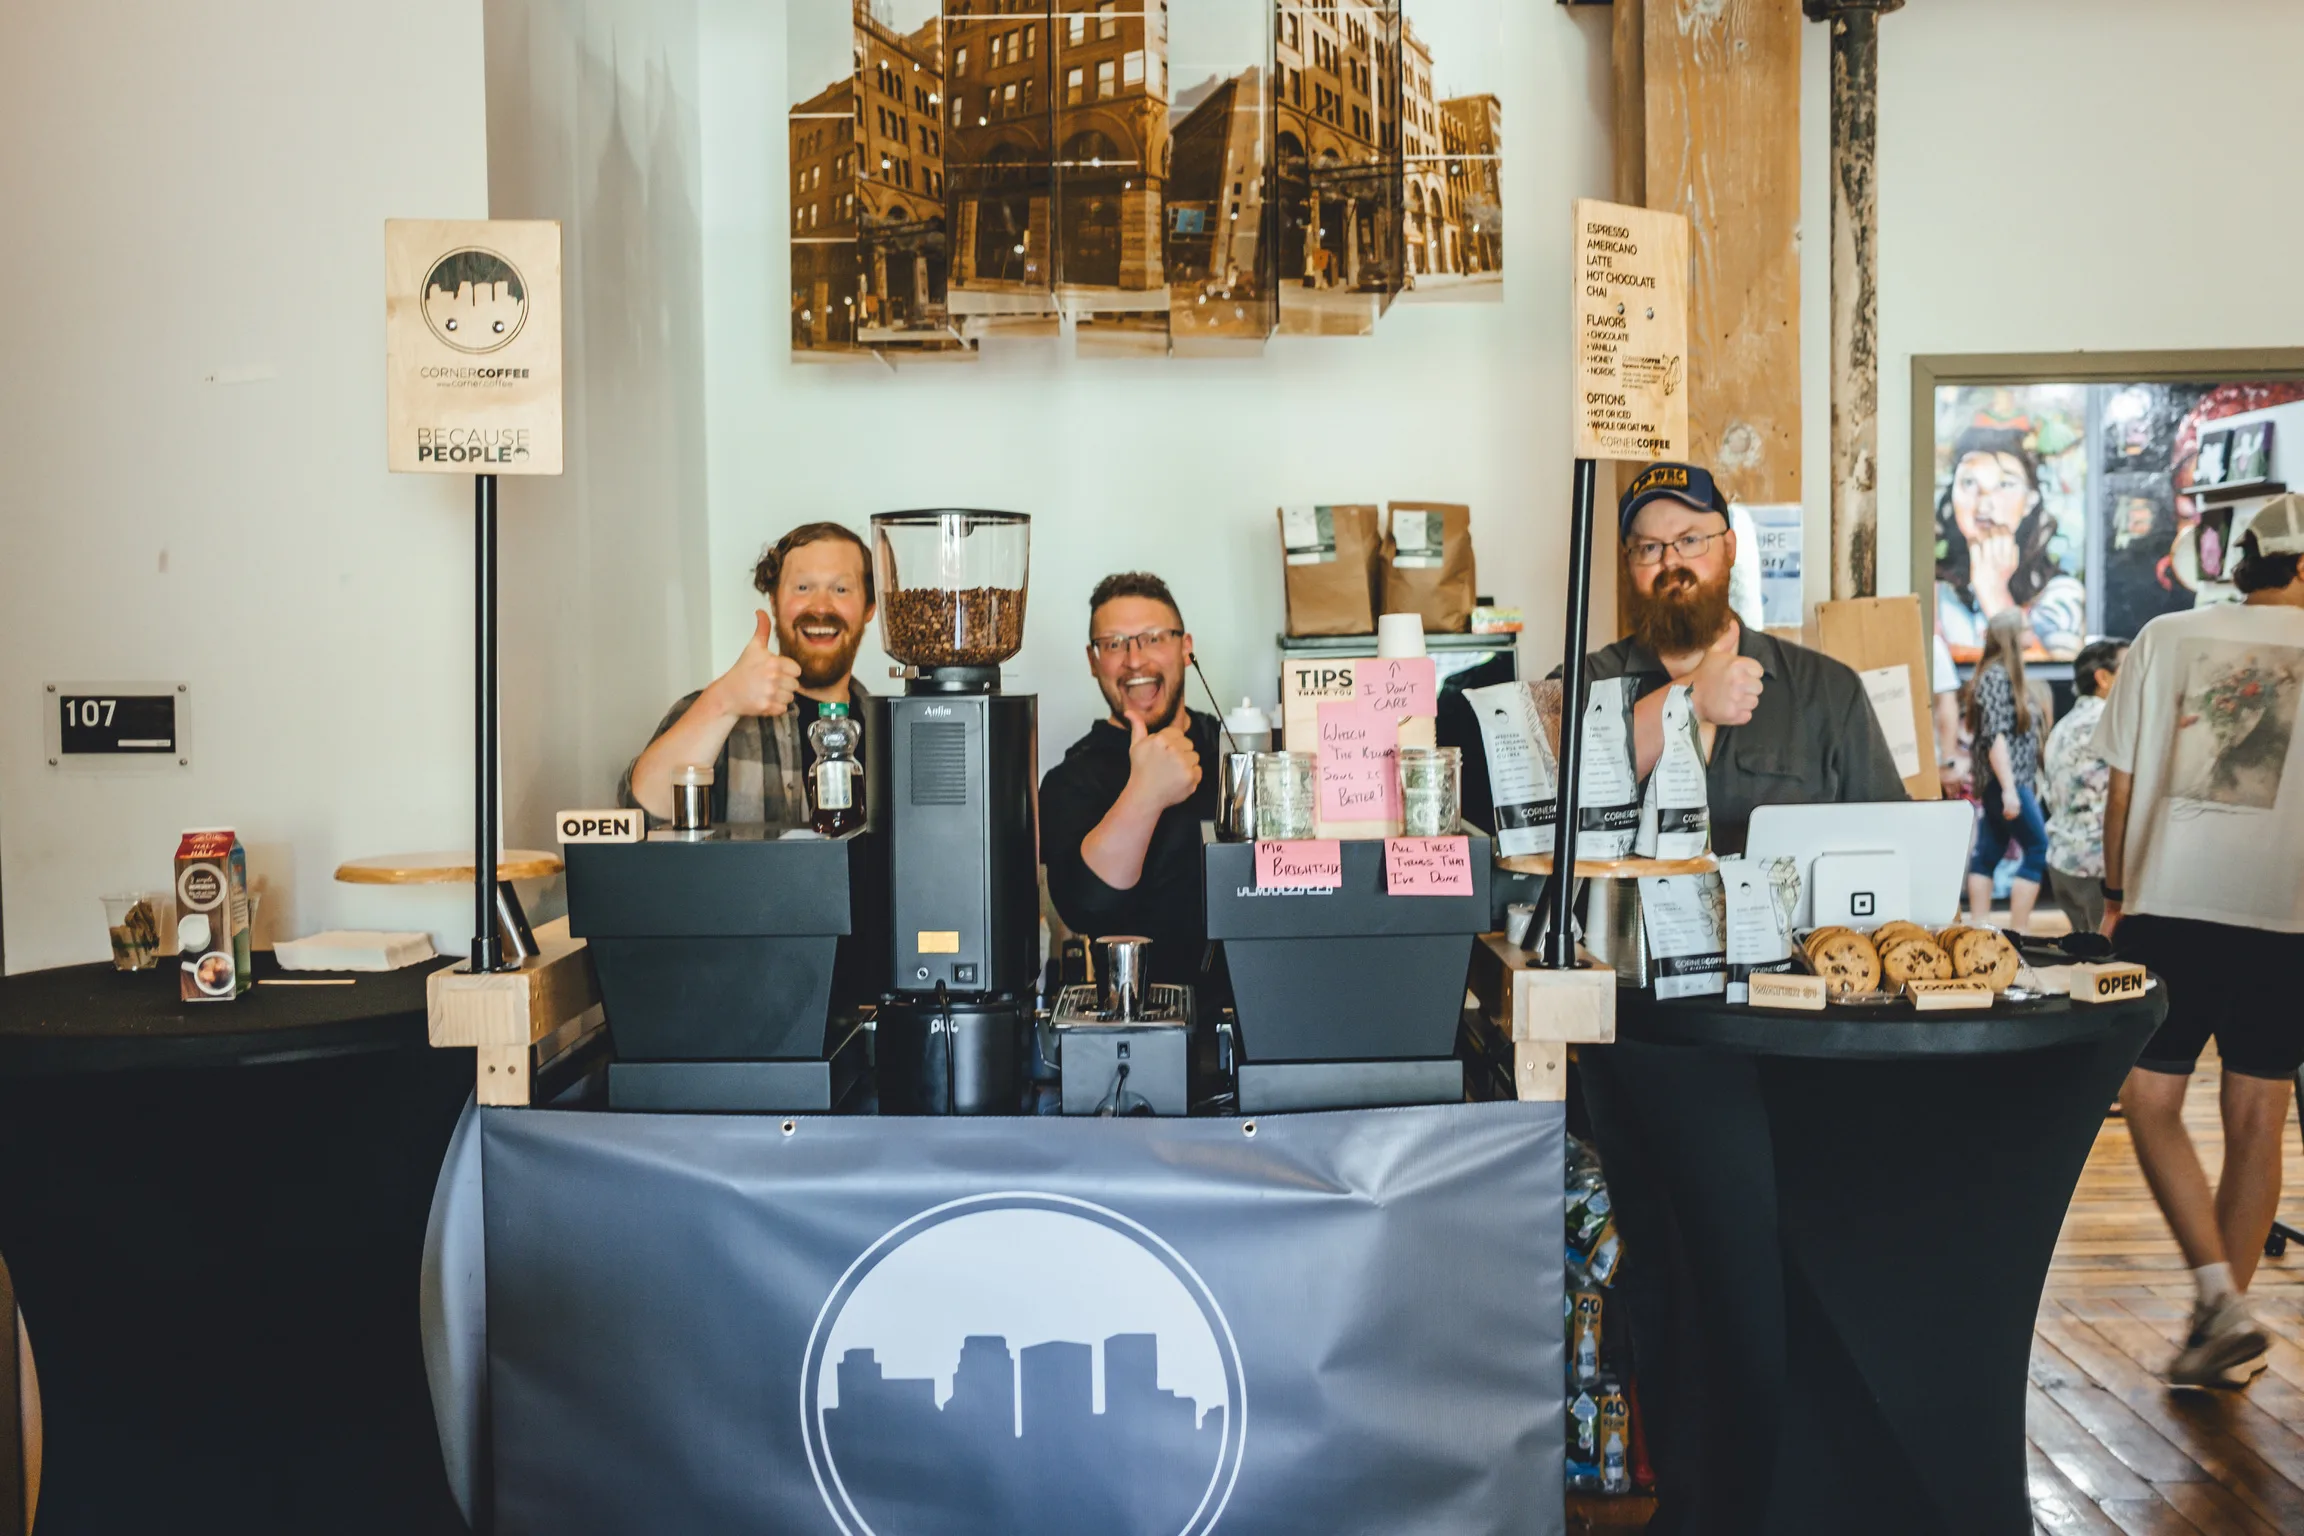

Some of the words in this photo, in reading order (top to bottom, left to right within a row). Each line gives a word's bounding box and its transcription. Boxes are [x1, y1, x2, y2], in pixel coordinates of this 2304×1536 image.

[1586, 222, 1630, 239] ESPRESSO
[1586, 238, 1638, 256] AMERICANO
[1586, 253, 1613, 268] LATTE
[1586, 270, 1604, 282] HOT
[1605, 272, 1656, 289] CHOCOLATE
[1586, 285, 1607, 298] CHAI
[1586, 313, 1627, 329] FLAVORS
[1590, 330, 1629, 342] CHOCOLATE
[1590, 342, 1618, 353] VANILLA
[1590, 354, 1614, 364] HONEY
[420, 367, 529, 379] CORNERCOFFEE
[1590, 366, 1616, 377] NORDIC
[1586, 391, 1626, 407] OPTIONS
[1590, 408, 1604, 418] HOT
[1605, 409, 1616, 419] OR
[1616, 410, 1632, 420] ICED
[1590, 420, 1616, 431] WHOLE
[1616, 421, 1627, 431] OR
[1626, 422, 1641, 432] OAT
[1640, 423, 1656, 433] MILK
[418, 428, 529, 446] BECAUSE
[1600, 435, 1671, 450] CORNERCOFFEE
[418, 446, 513, 463] PEOPLE
[1296, 669, 1353, 689] TIPS
[1298, 689, 1330, 697] THANK
[1333, 689, 1352, 697] YOU
[1373, 697, 1408, 711] CARE
[65, 700, 117, 727] 107
[562, 819, 630, 836] OPEN
[2098, 973, 2143, 995] OPEN
[1578, 1297, 1600, 1314] 40
[1604, 1400, 1626, 1417] 40
